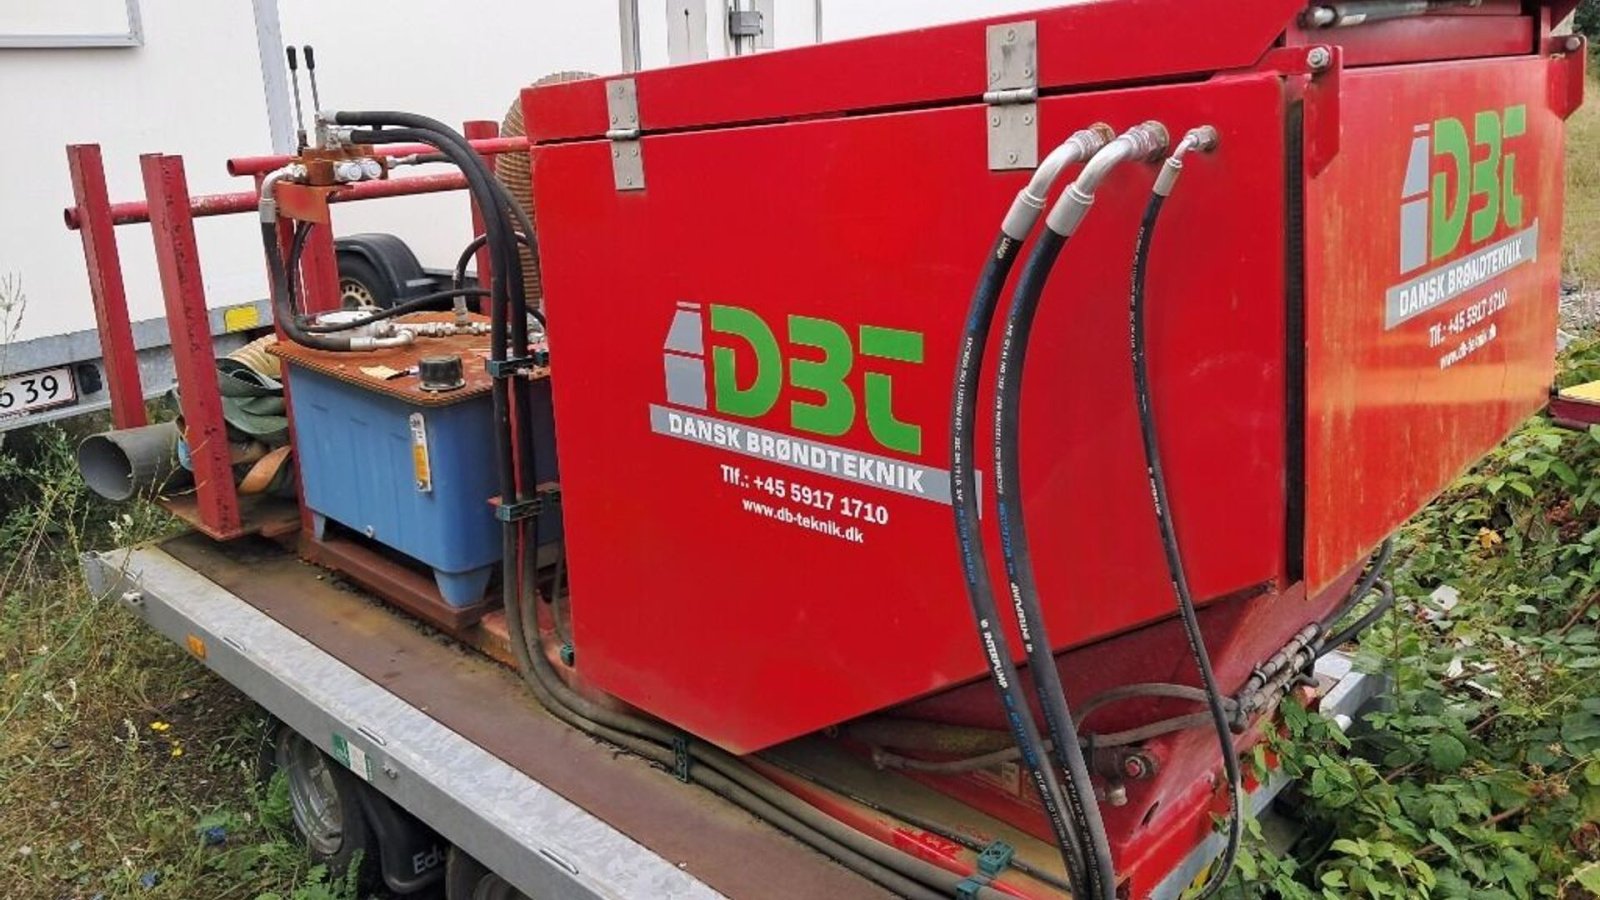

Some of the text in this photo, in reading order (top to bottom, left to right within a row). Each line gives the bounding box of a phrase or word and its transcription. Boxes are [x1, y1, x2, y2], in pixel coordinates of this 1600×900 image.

[1400, 278, 1445, 317] DANSK
[20, 374, 59, 404] 39
[668, 412, 925, 493] DANSK BRØNDTEKNIK
[720, 464, 889, 525] Tlf.: +45 5917 1710
[742, 499, 864, 543] www.db-teknik.dk
[1010, 582, 1030, 640] INTERPUMP
[983, 631, 1008, 689] INTERPUMP
